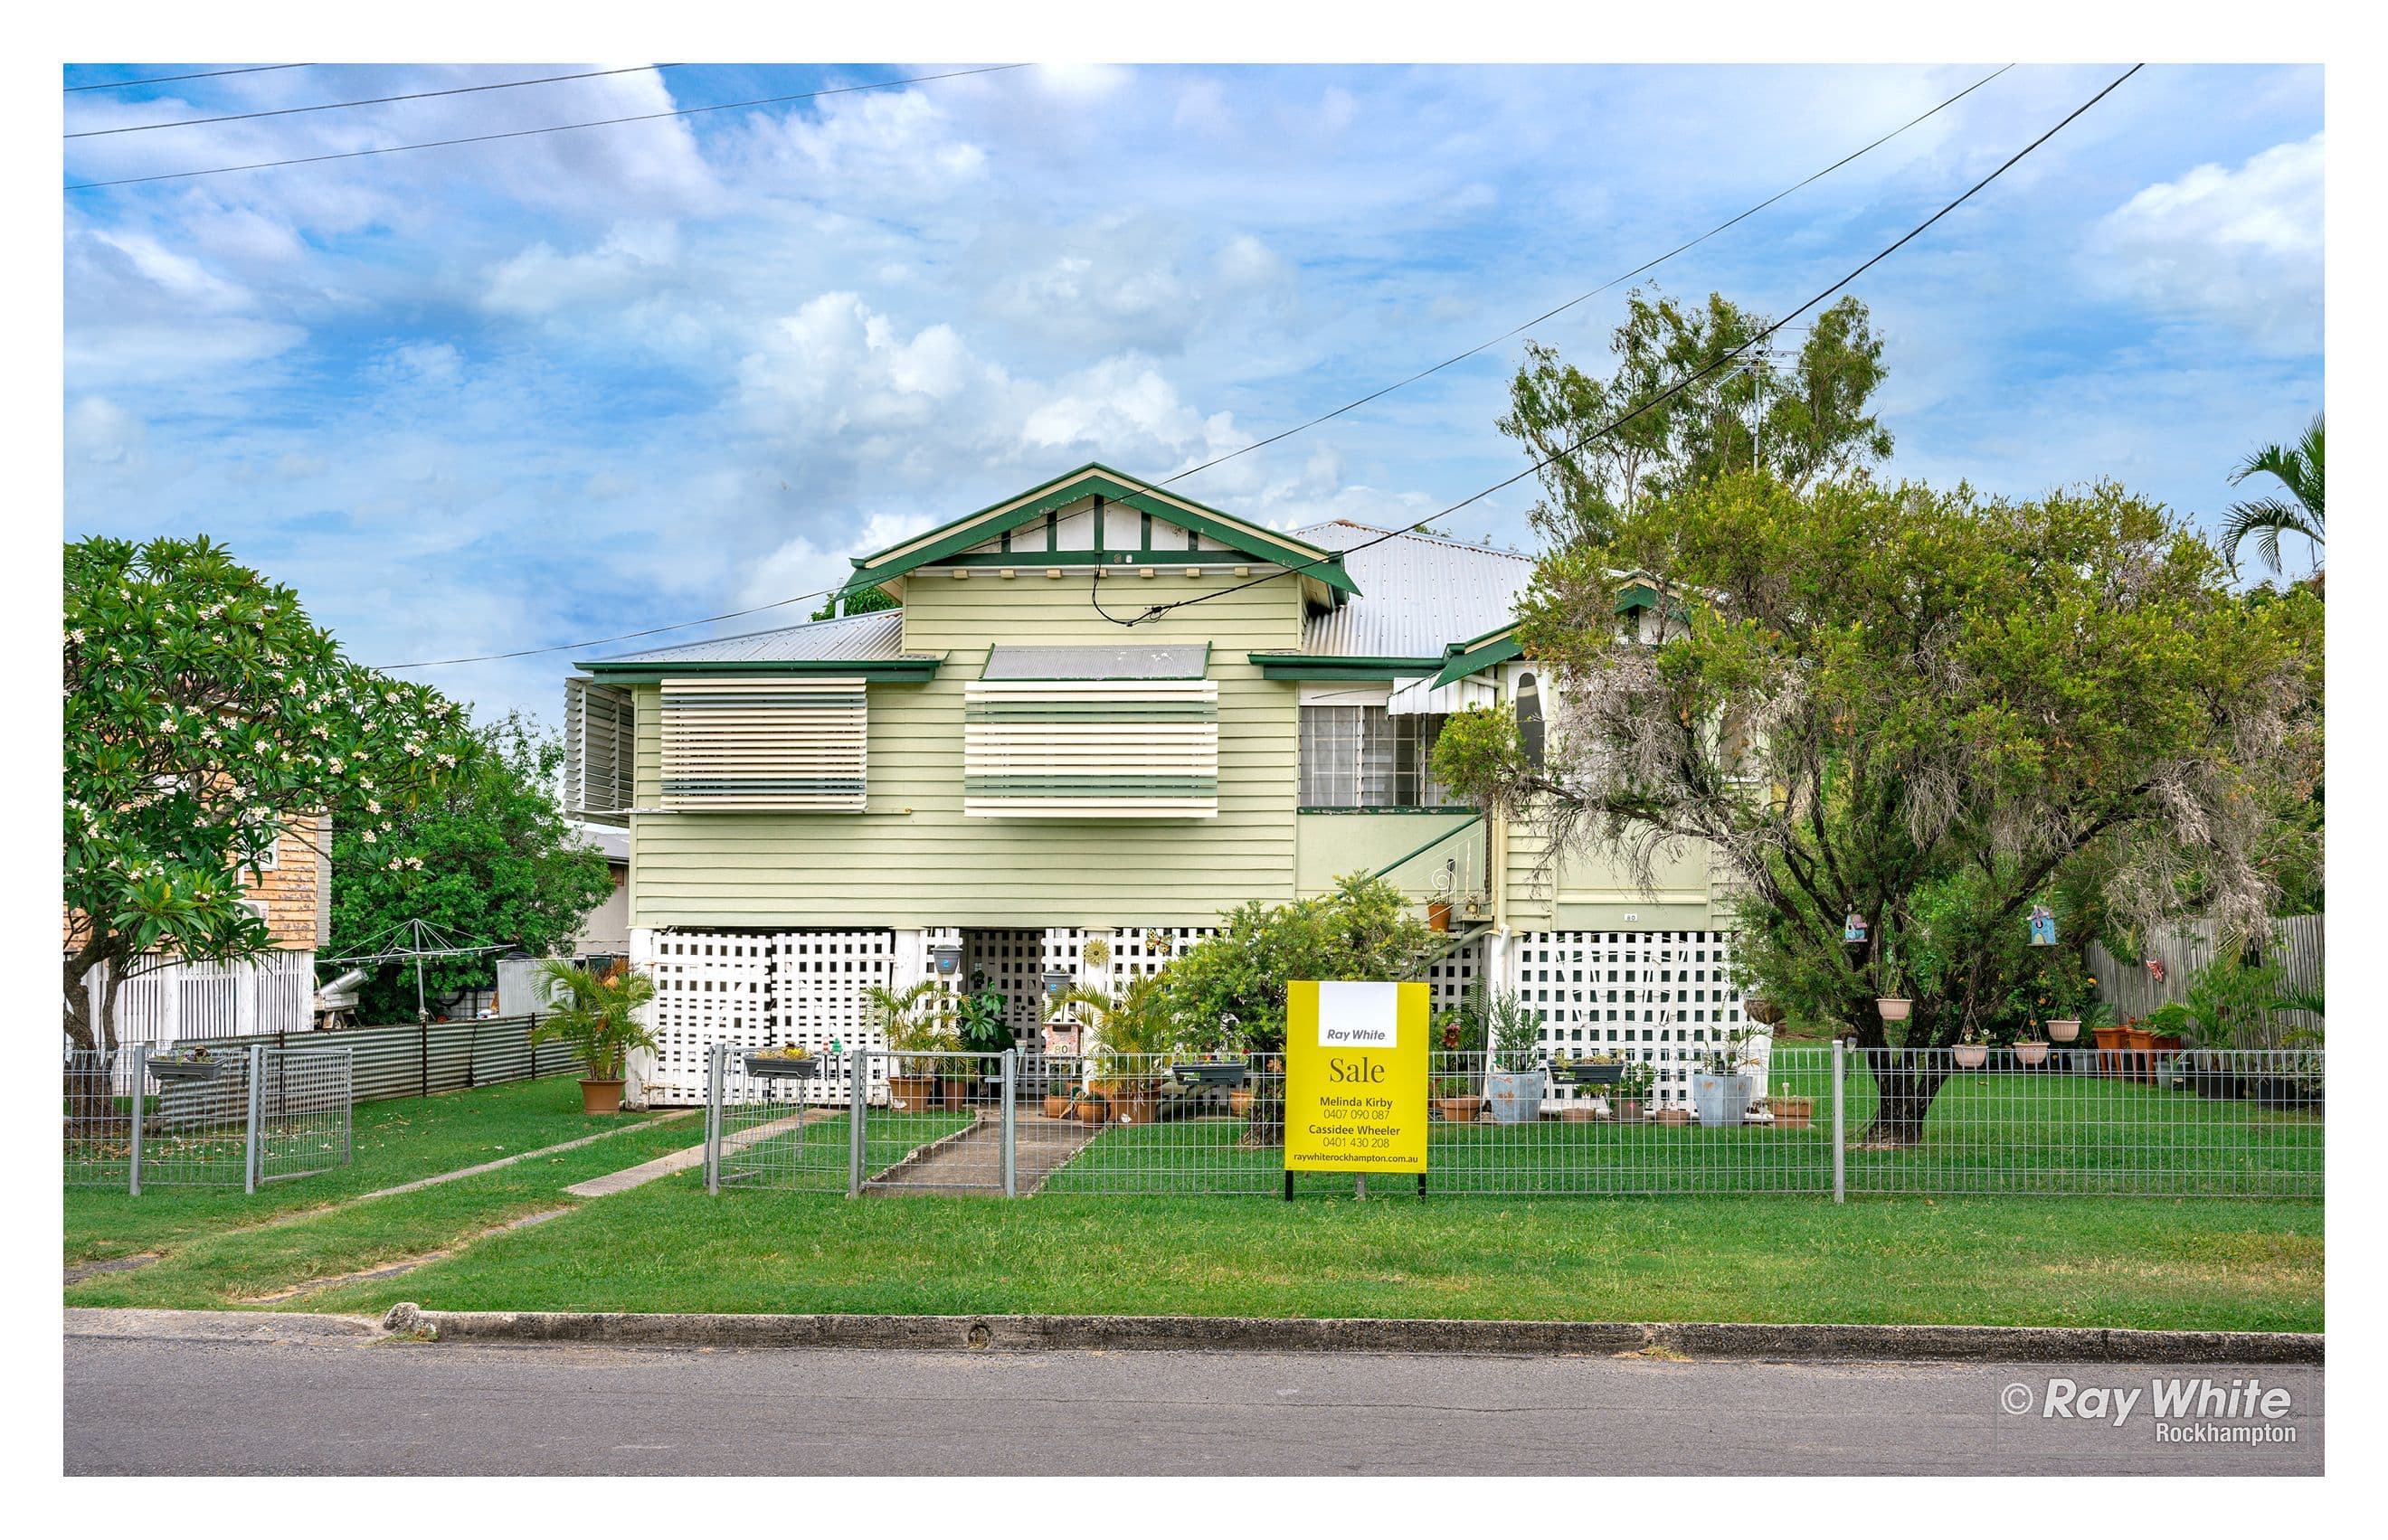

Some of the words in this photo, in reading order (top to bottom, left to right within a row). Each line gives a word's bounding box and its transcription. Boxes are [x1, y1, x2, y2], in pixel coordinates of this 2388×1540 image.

[1327, 1029, 1350, 1041] Ray
[1351, 1029, 1386, 1041] White
[1054, 1045, 1068, 1054] 80
[1330, 1056, 1385, 1083] Sale
[1320, 1097, 1362, 1107] Melinda
[1365, 1098, 1393, 1110] Kirby
[1323, 1109, 1348, 1120] 0407
[1350, 1110, 1369, 1120] 090
[1371, 1110, 1390, 1120] 087
[1308, 1124, 1354, 1135] Cassidee
[1357, 1125, 1401, 1136] Wheeler
[1322, 1137, 1347, 1148] 0401
[1350, 1138, 1369, 1148] 430
[1370, 1138, 1390, 1148] 208
[1294, 1152, 1418, 1164] raywhiterockhampton.com.au
